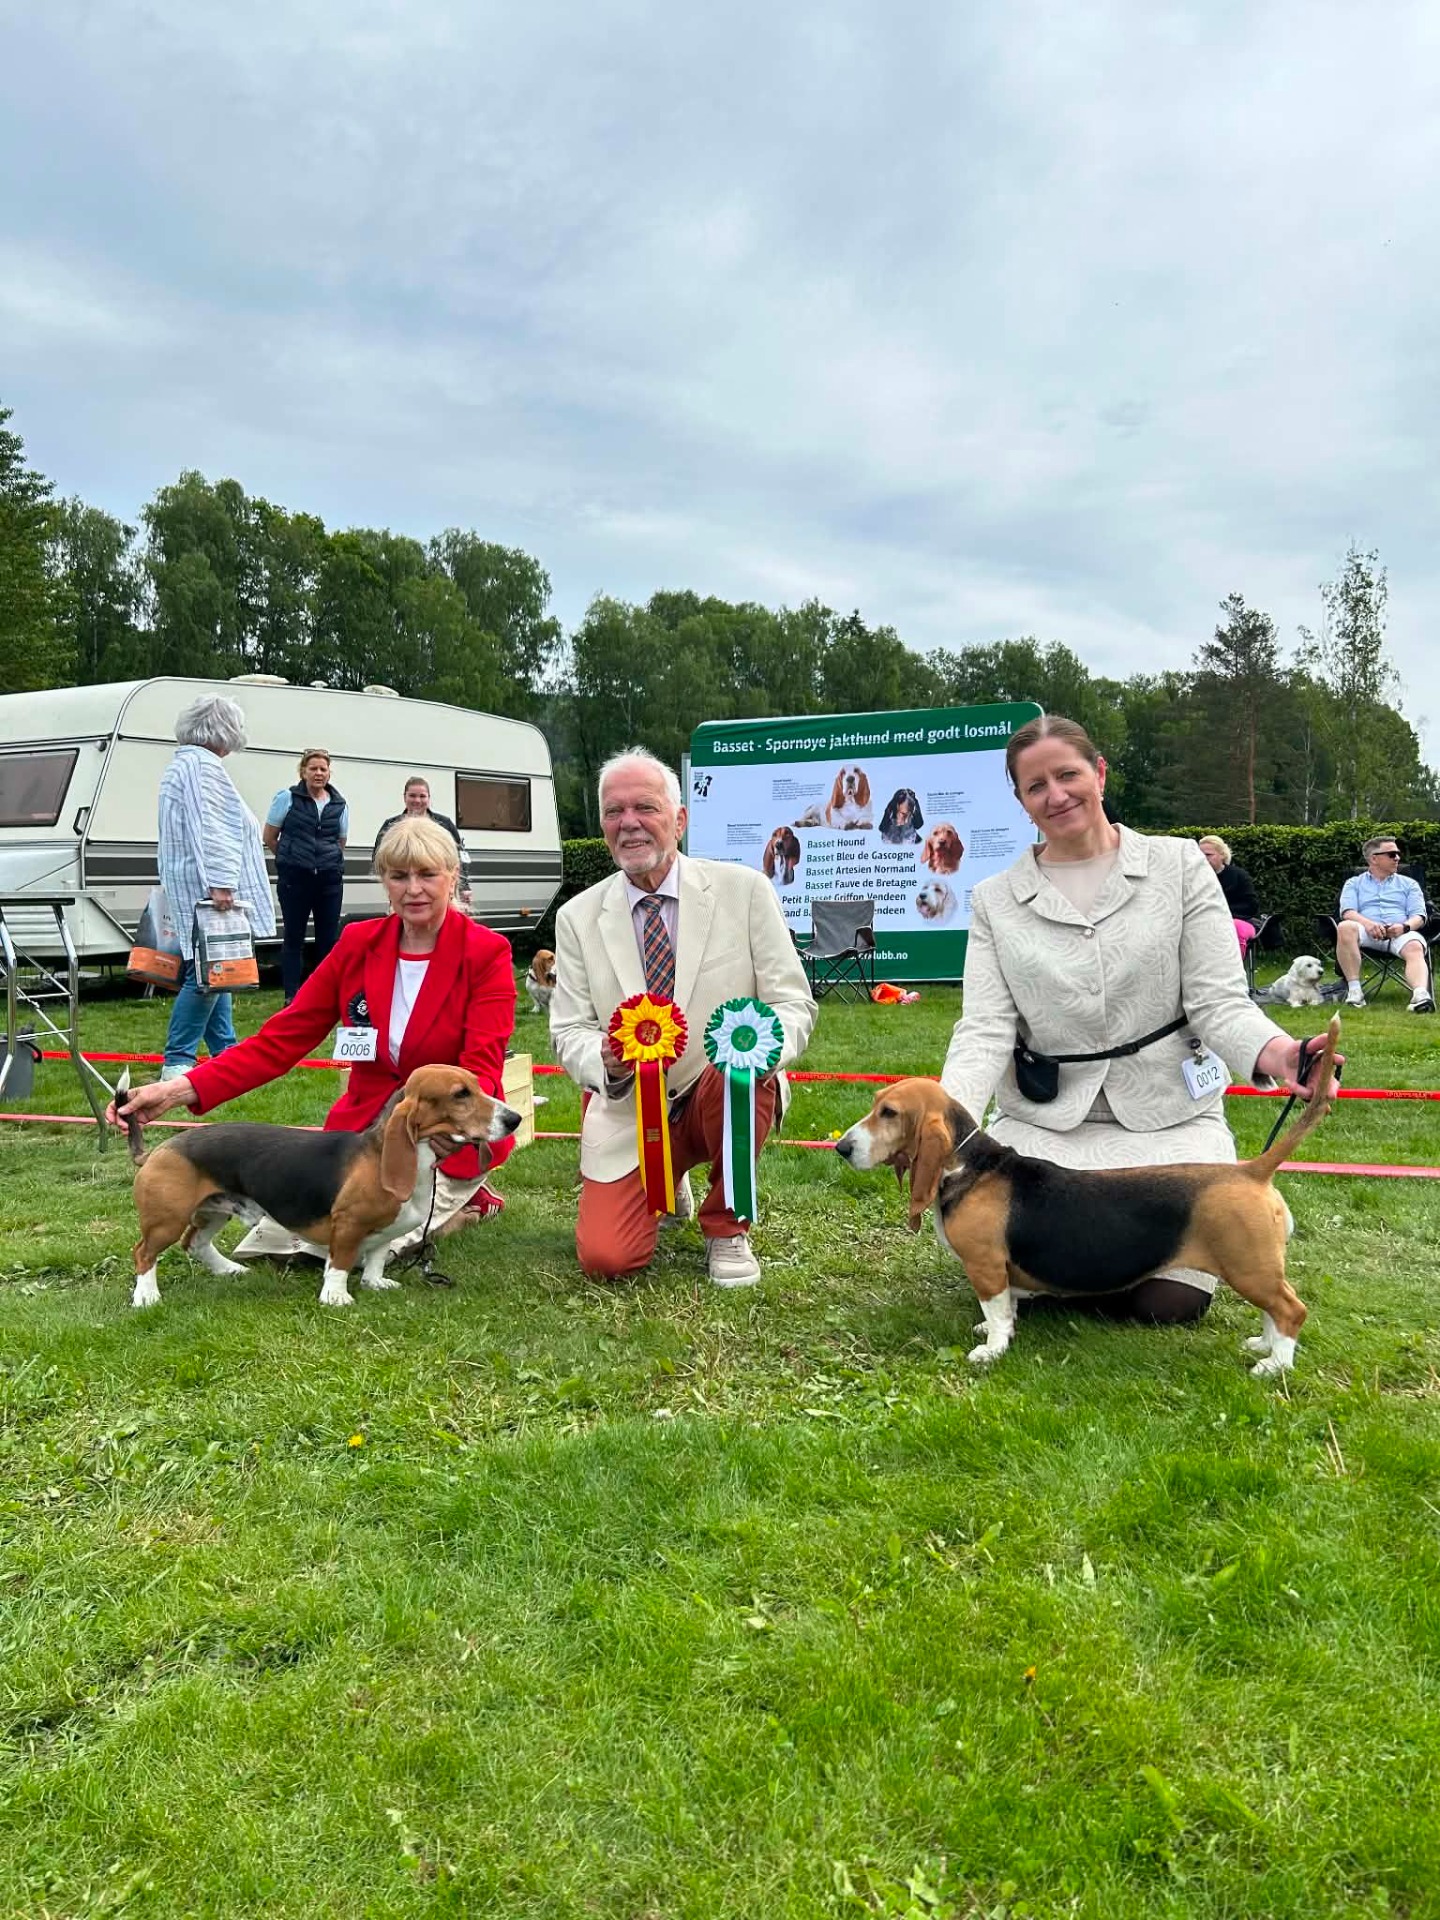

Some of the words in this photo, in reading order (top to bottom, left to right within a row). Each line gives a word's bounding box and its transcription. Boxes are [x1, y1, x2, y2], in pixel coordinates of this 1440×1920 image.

[713, 740, 754, 753] Basset
[765, 737, 826, 754] Spornøye
[829, 730, 889, 751] jakthund
[894, 728, 924, 743] med
[927, 725, 961, 744] godt
[964, 721, 1012, 738] losmål
[807, 840, 835, 849] Basset
[837, 838, 866, 847] Hound
[806, 854, 835, 863] Basset
[836, 852, 855, 861] Bleu
[858, 851, 869, 860] de
[871, 851, 915, 862] Gascogne
[806, 867, 834, 876] Basset
[835, 865, 872, 875] Artesien
[874, 864, 916, 873] Normand
[805, 881, 833, 890] Basset
[835, 879, 860, 889] Fauve
[862, 879, 874, 887] de
[876, 878, 918, 889] Bretagne
[782, 895, 802, 904] Petit
[834, 893, 865, 901] Griffon
[867, 892, 906, 901] Vendeen
[341, 1043, 371, 1056] 0006
[1196, 1066, 1221, 1089] 0012
